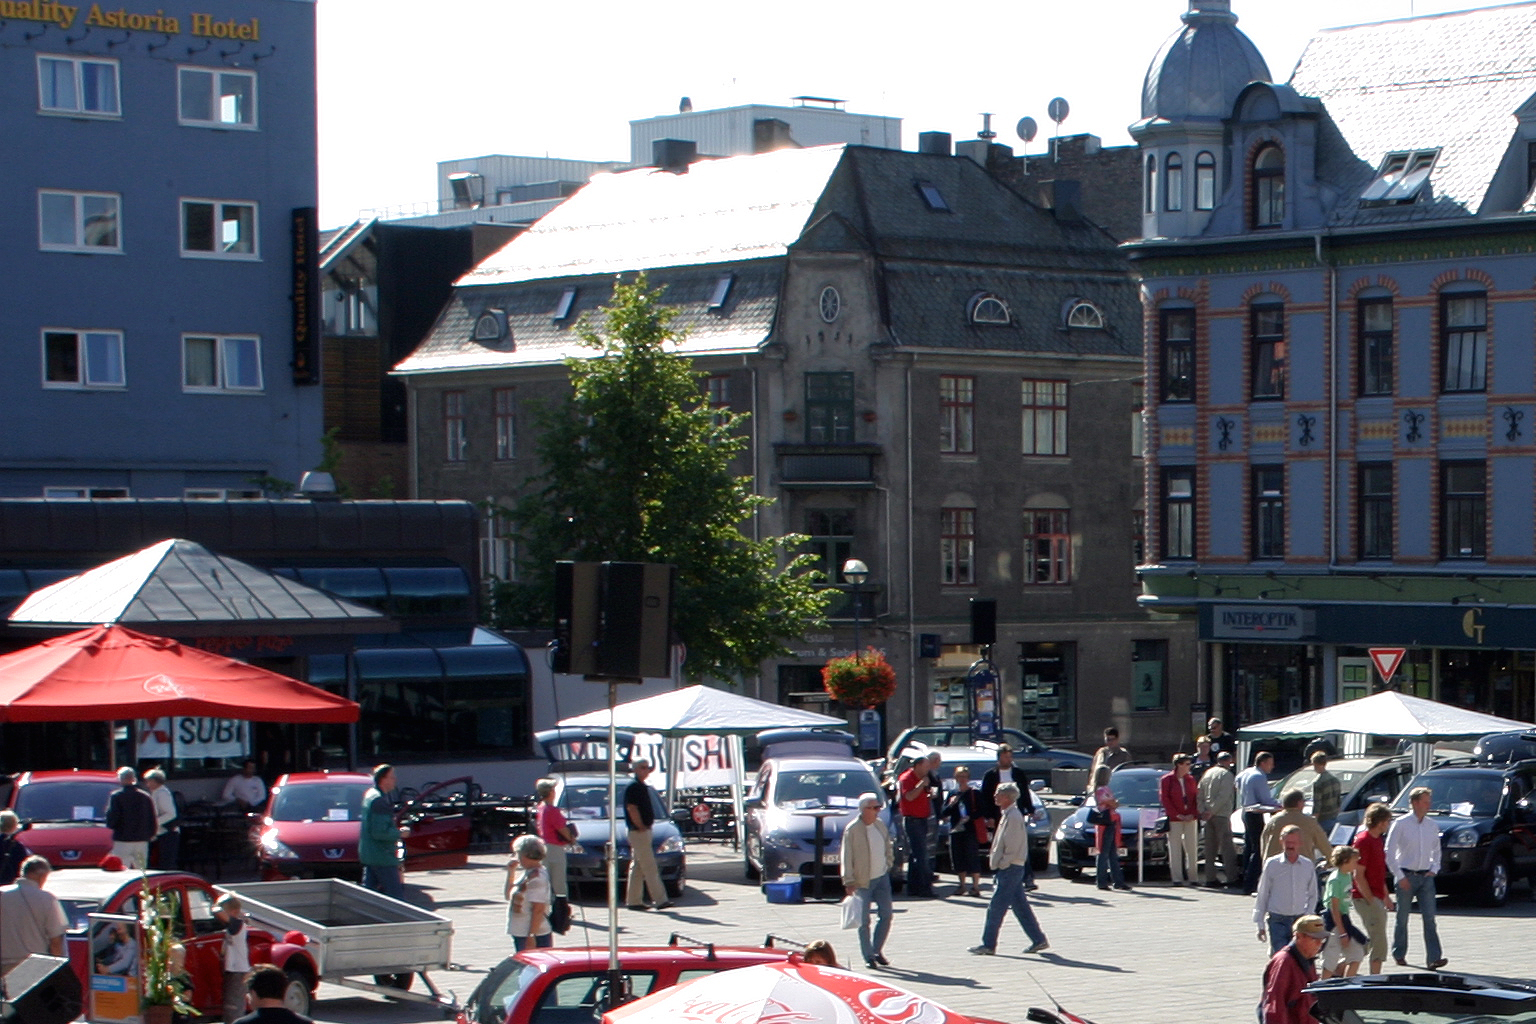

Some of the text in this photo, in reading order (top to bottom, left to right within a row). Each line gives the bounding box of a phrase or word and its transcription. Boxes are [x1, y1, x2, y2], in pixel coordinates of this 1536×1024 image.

[0, 0, 259, 41] uality Astoria Hotel
[1222, 611, 1297, 626] INTEROPTIK
[563, 738, 732, 774] MISUISHI
